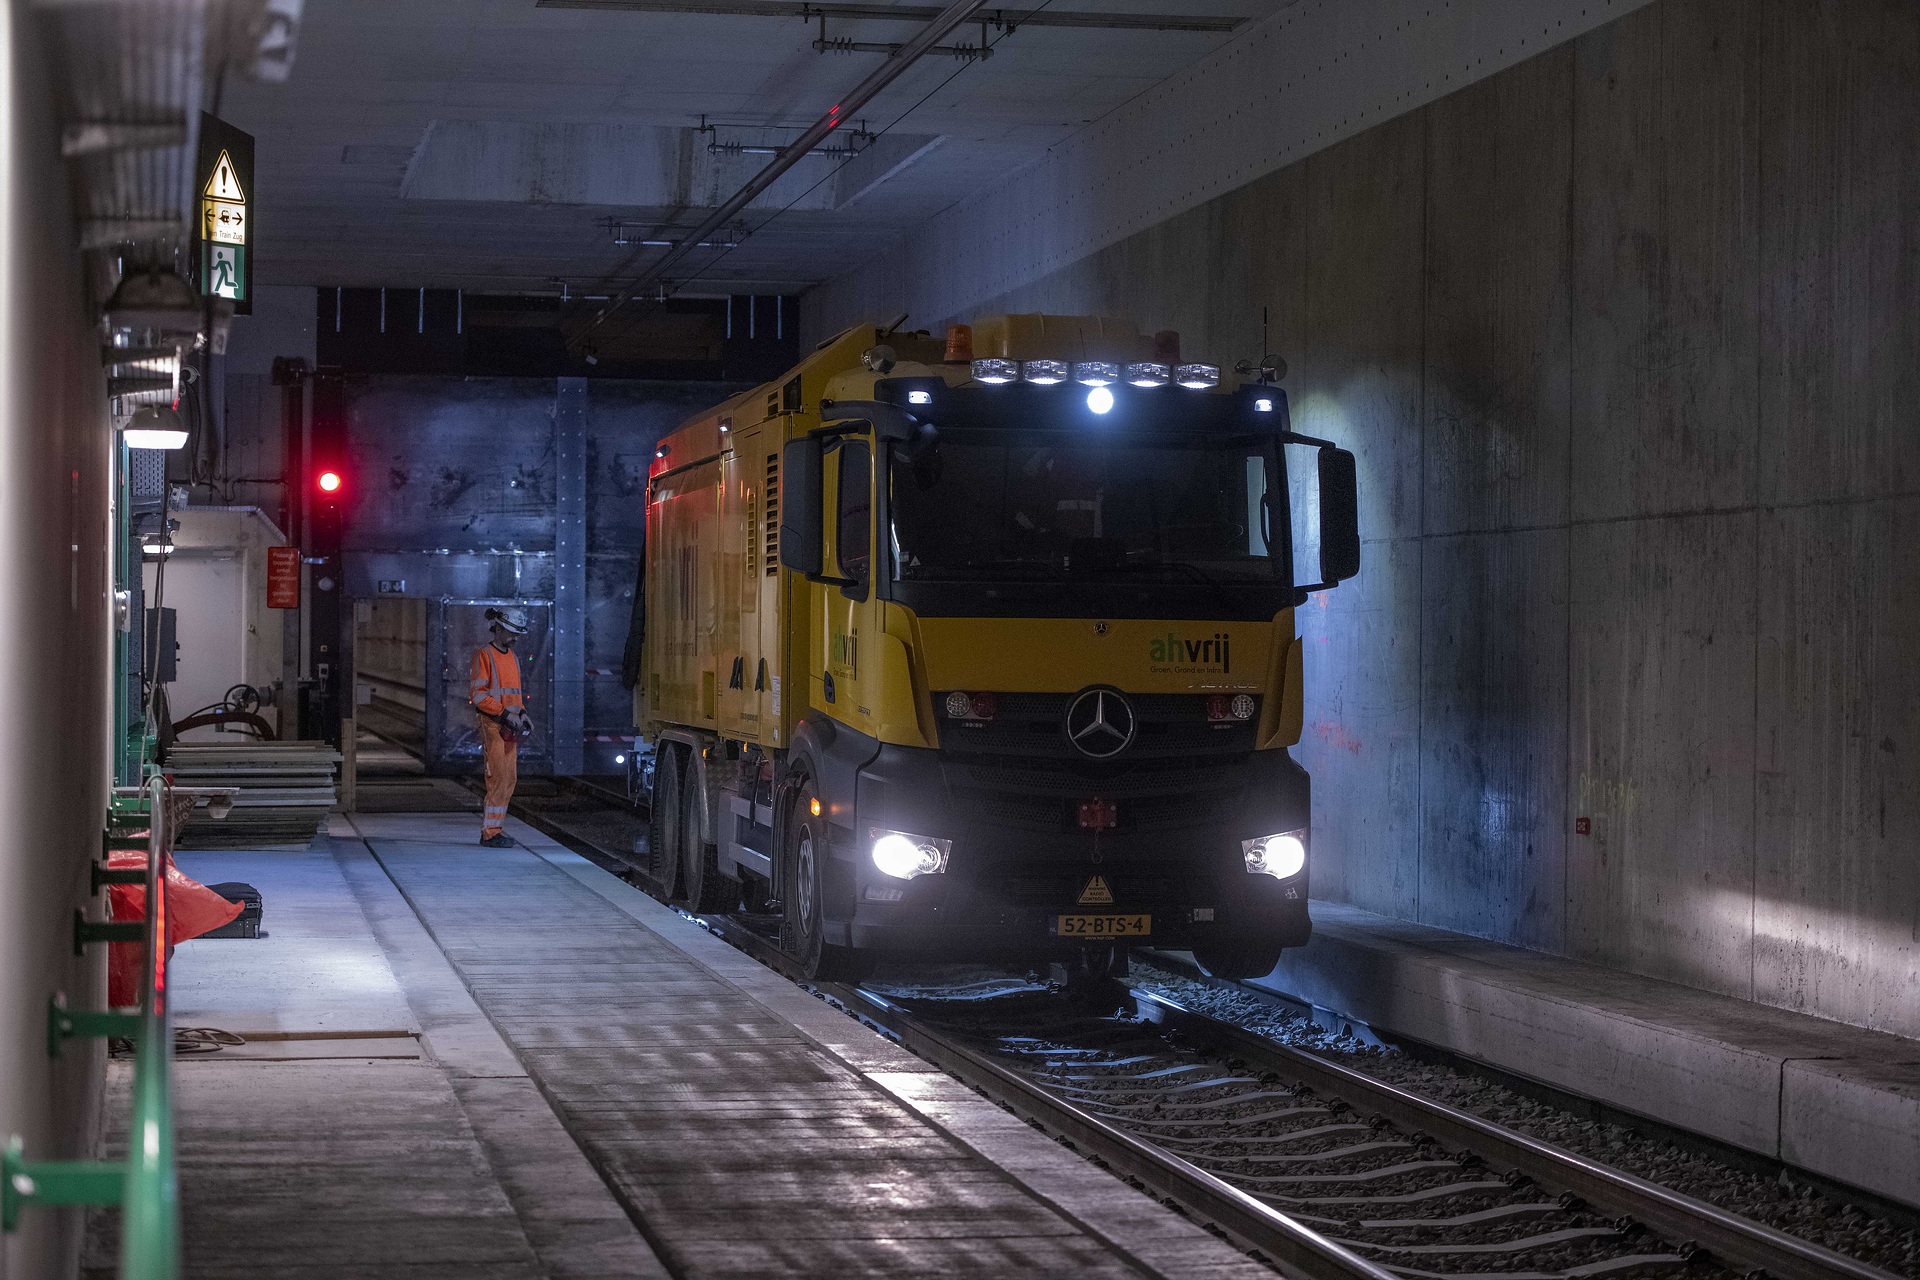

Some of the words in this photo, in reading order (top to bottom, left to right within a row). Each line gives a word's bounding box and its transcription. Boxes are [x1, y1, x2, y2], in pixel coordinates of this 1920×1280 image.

[219, 231, 232, 240] Train
[233, 233, 243, 243] Zug
[1150, 632, 1230, 674] ahvrij
[1065, 918, 1144, 933] 52-BTS-4
